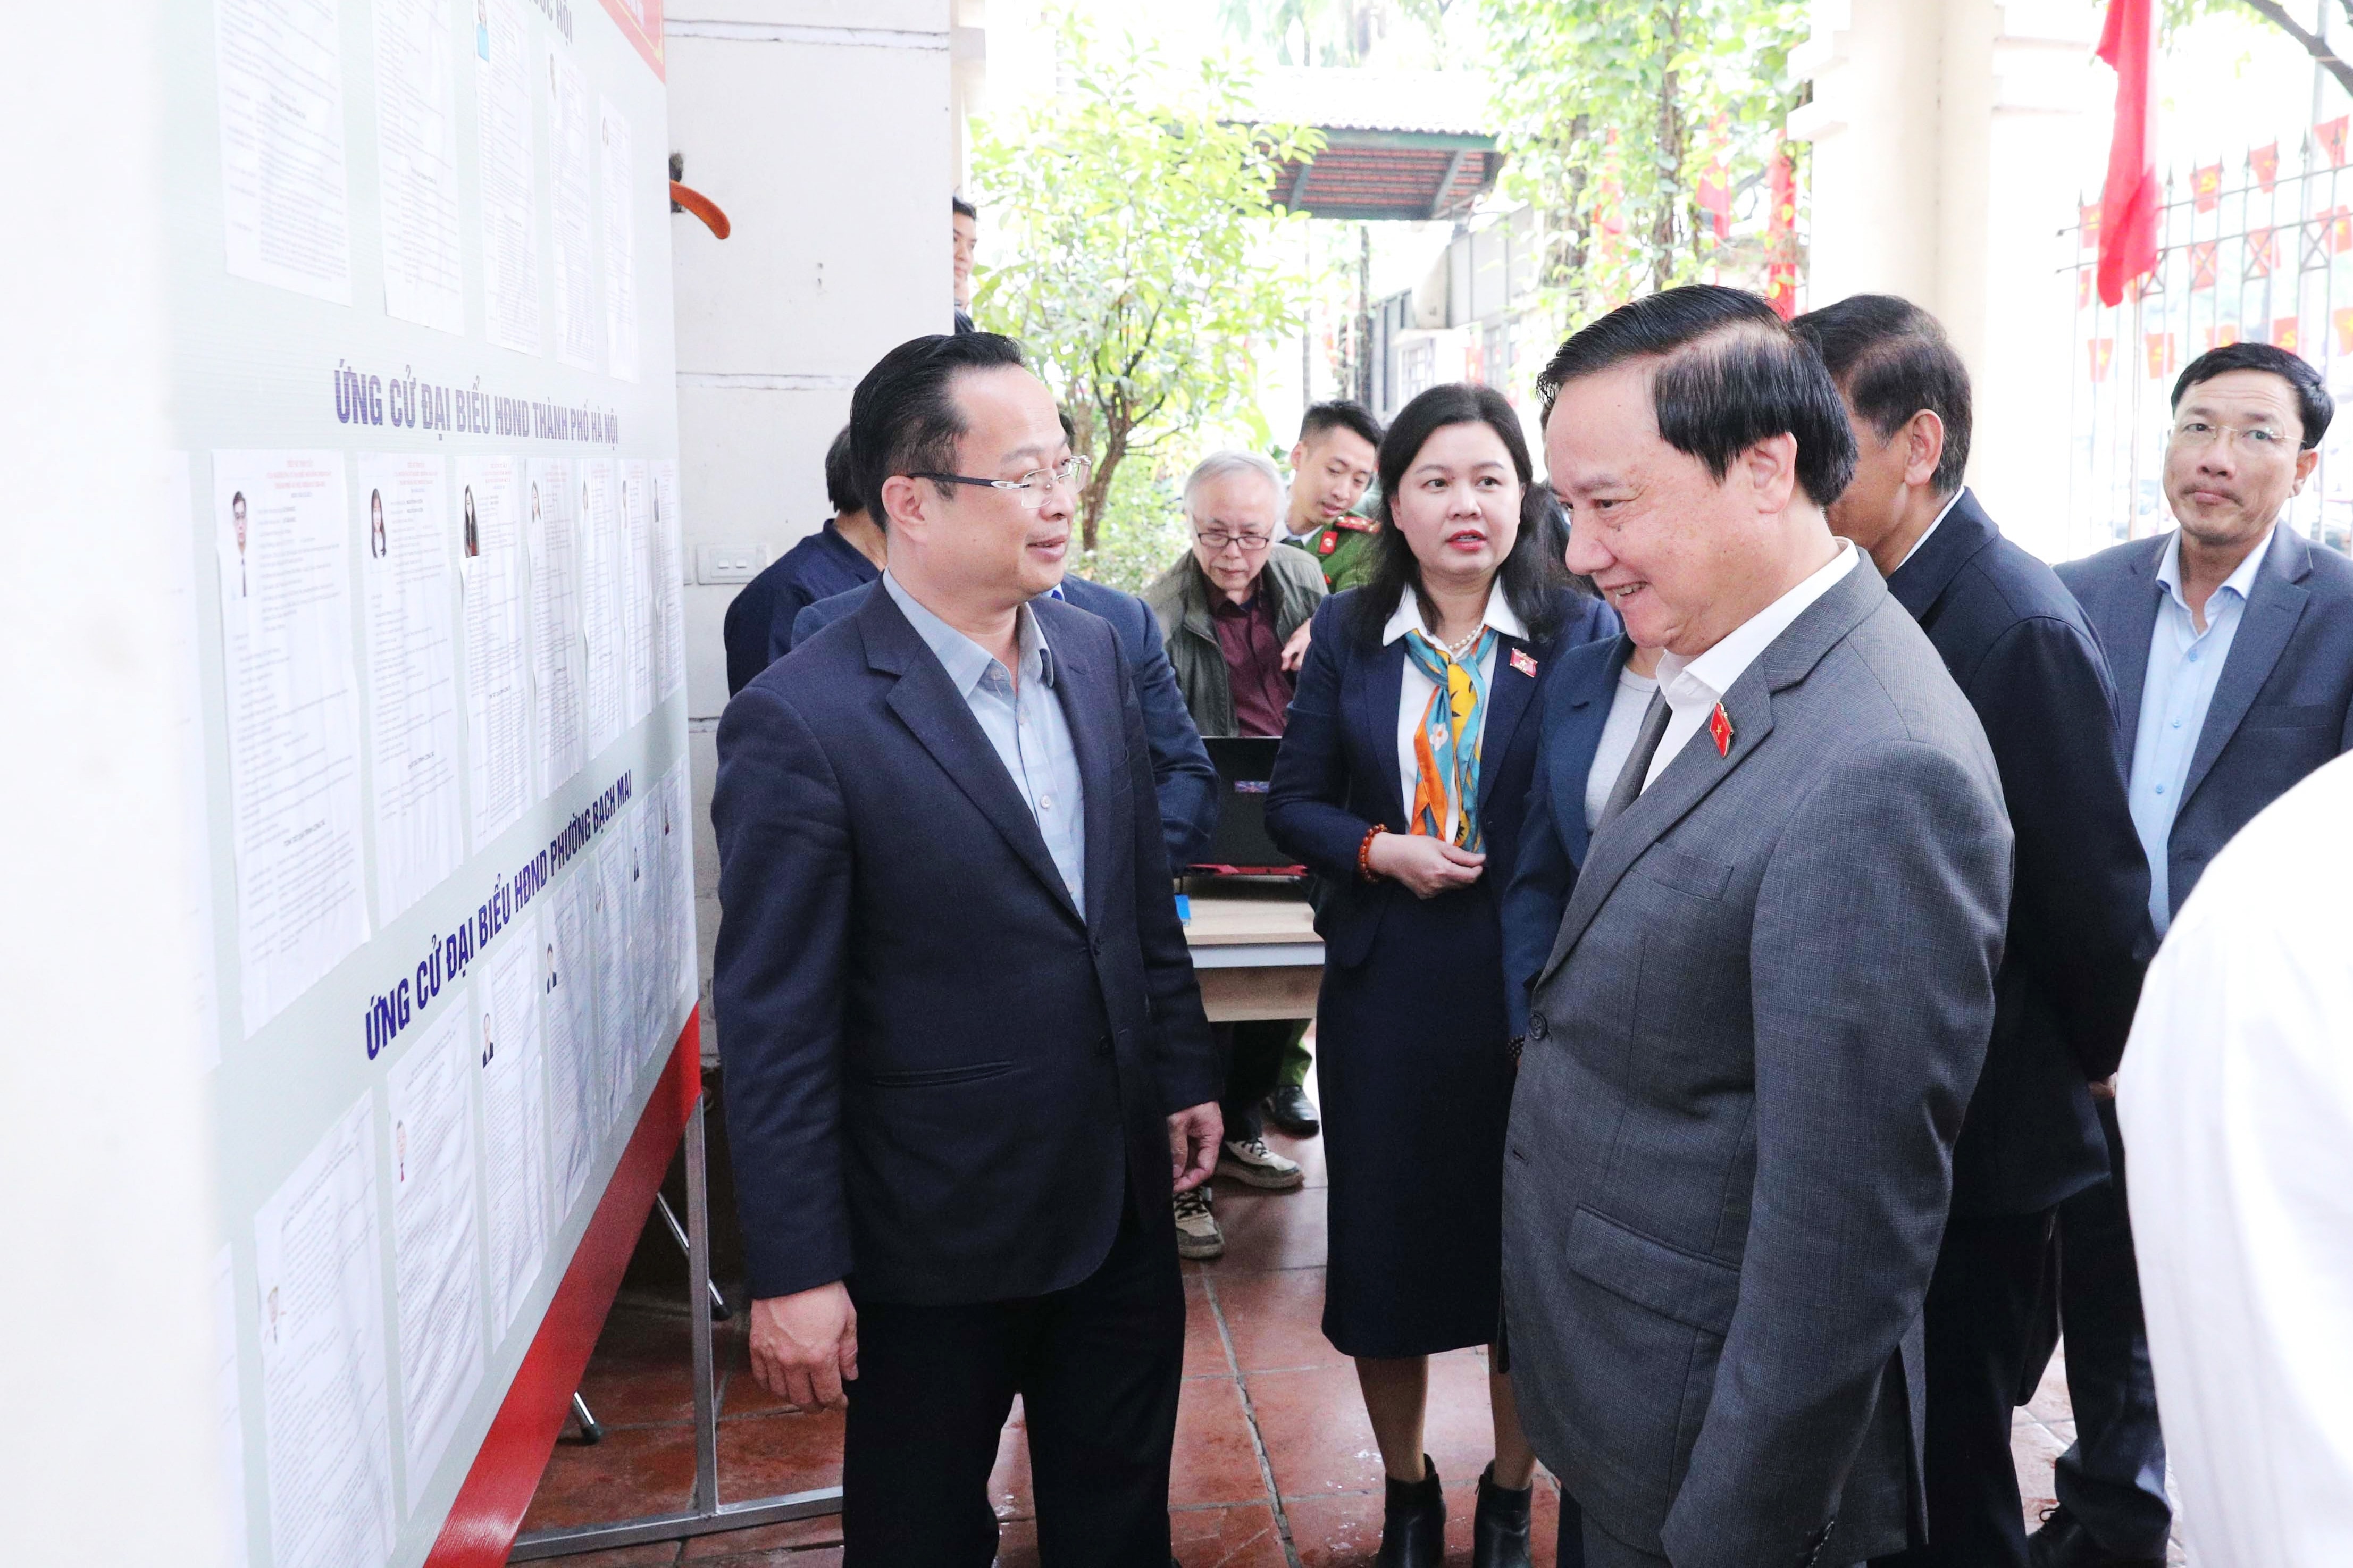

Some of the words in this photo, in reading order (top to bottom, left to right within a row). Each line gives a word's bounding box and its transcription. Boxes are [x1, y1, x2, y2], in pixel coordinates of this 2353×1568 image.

[334, 358, 383, 426] ỨNG
[389, 364, 416, 429] CỬ
[421, 383, 451, 441] ĐẠI
[455, 375, 490, 435] BIỂU
[494, 396, 530, 437] HĐND
[532, 396, 568, 440] THÀNH
[570, 398, 589, 442] PHỐ
[591, 405, 603, 443] HÀ
[604, 408, 618, 450] NỘI
[365, 978, 411, 1061] ỨNG
[416, 934, 442, 1010] CỬ
[446, 917, 474, 982] ĐẠI
[478, 873, 510, 950] BIỂU
[514, 849, 547, 913] HĐND
[550, 808, 591, 877] PHƯỜNG
[592, 784, 616, 834] BẠCH
[617, 769, 632, 810] MAI
